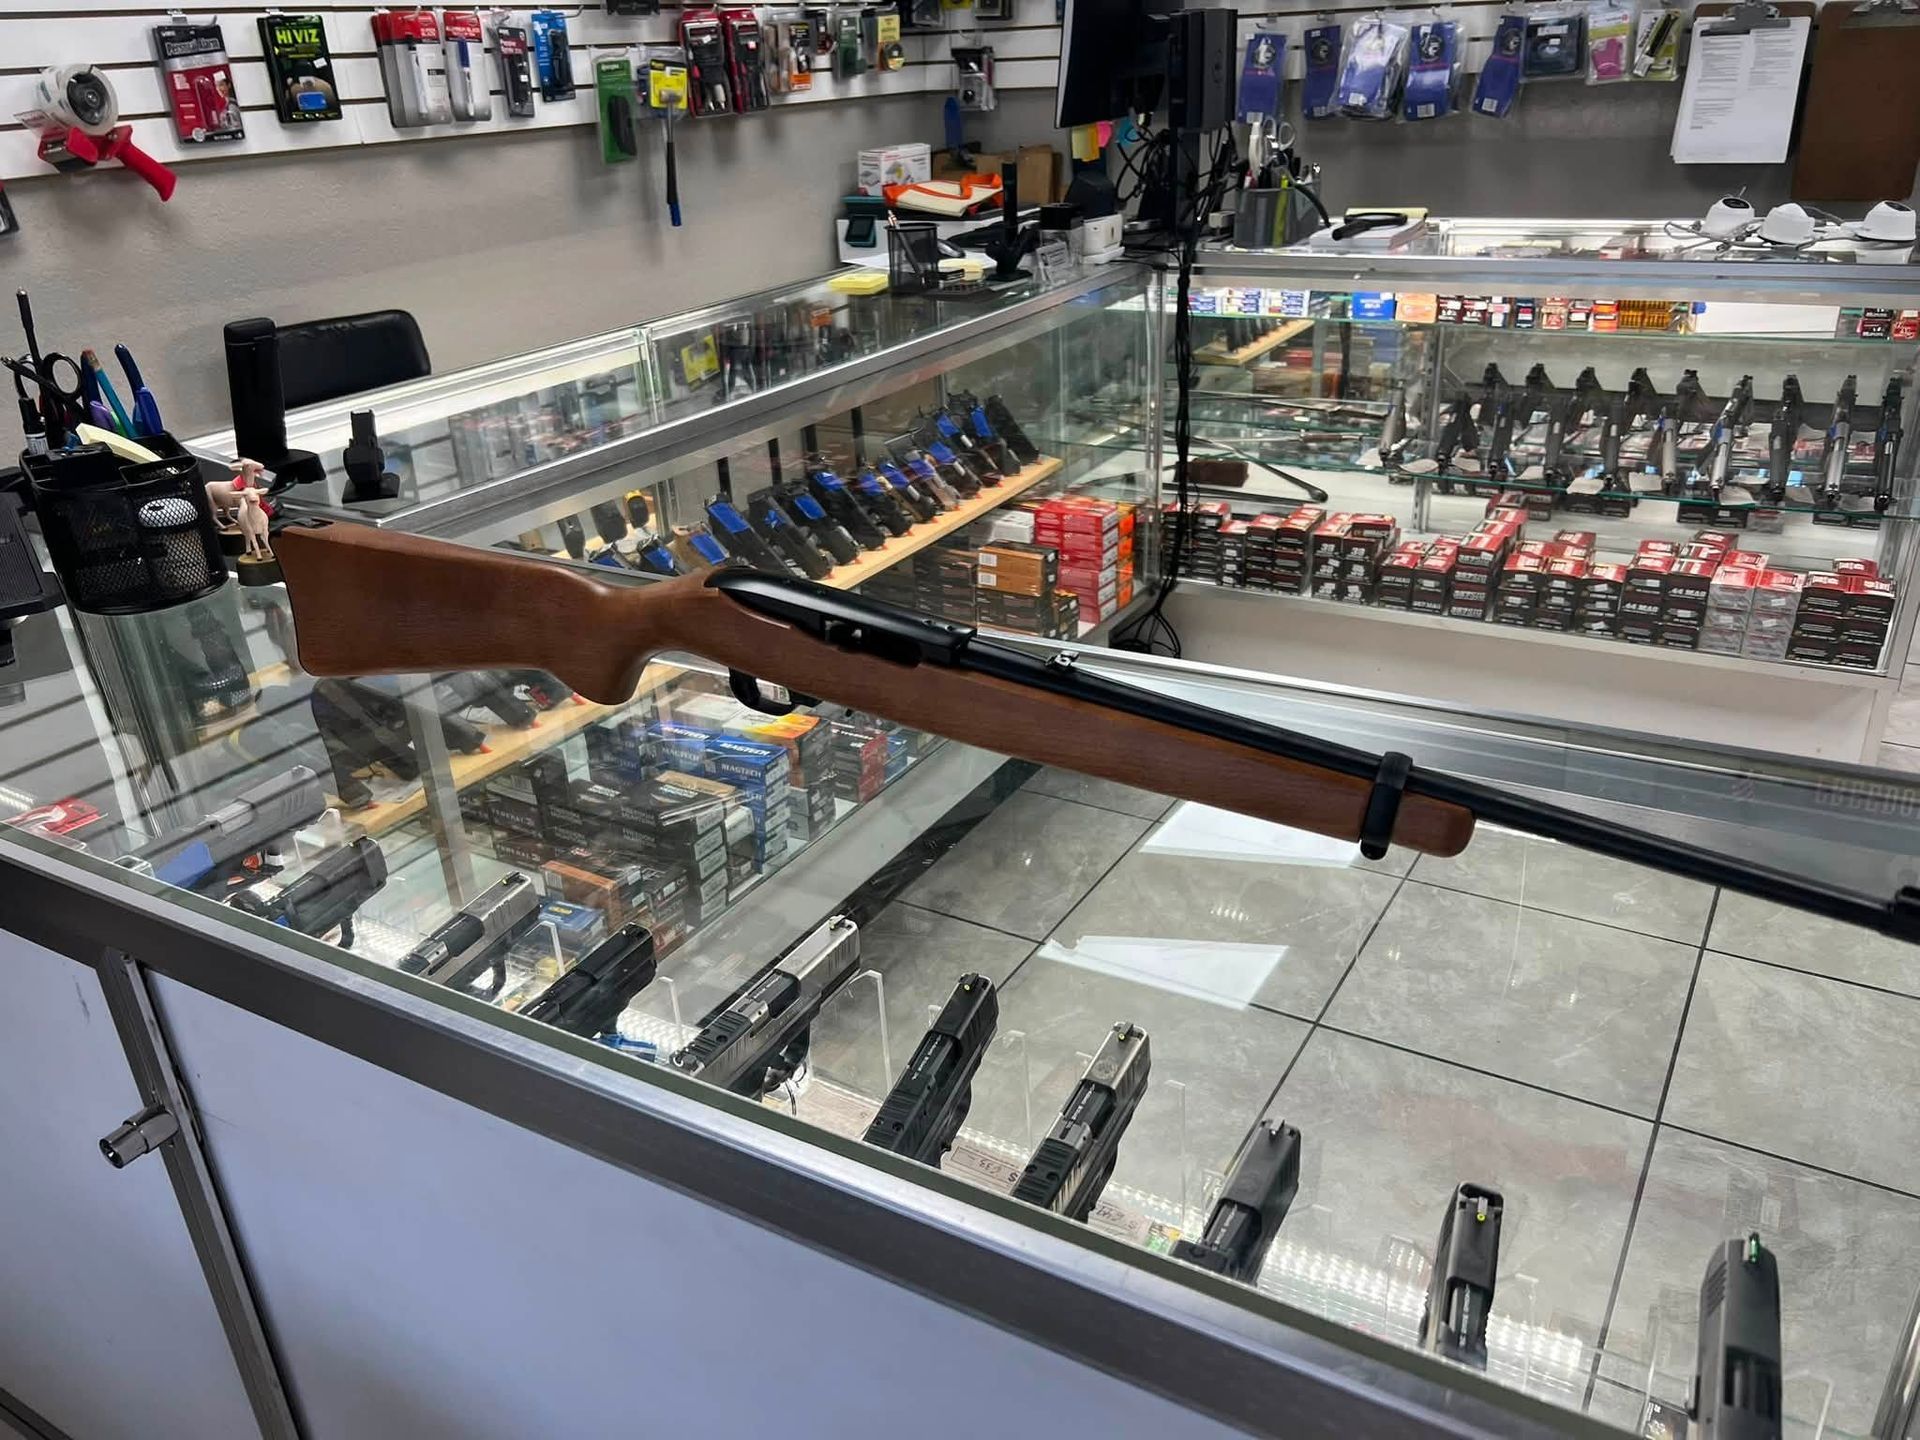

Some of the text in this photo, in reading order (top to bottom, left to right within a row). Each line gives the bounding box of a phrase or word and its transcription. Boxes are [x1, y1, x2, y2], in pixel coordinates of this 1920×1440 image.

[276, 28, 320, 44] HI VIZ
[720, 742, 771, 757] MAGTECH
[721, 763, 762, 777] MAGTECH
